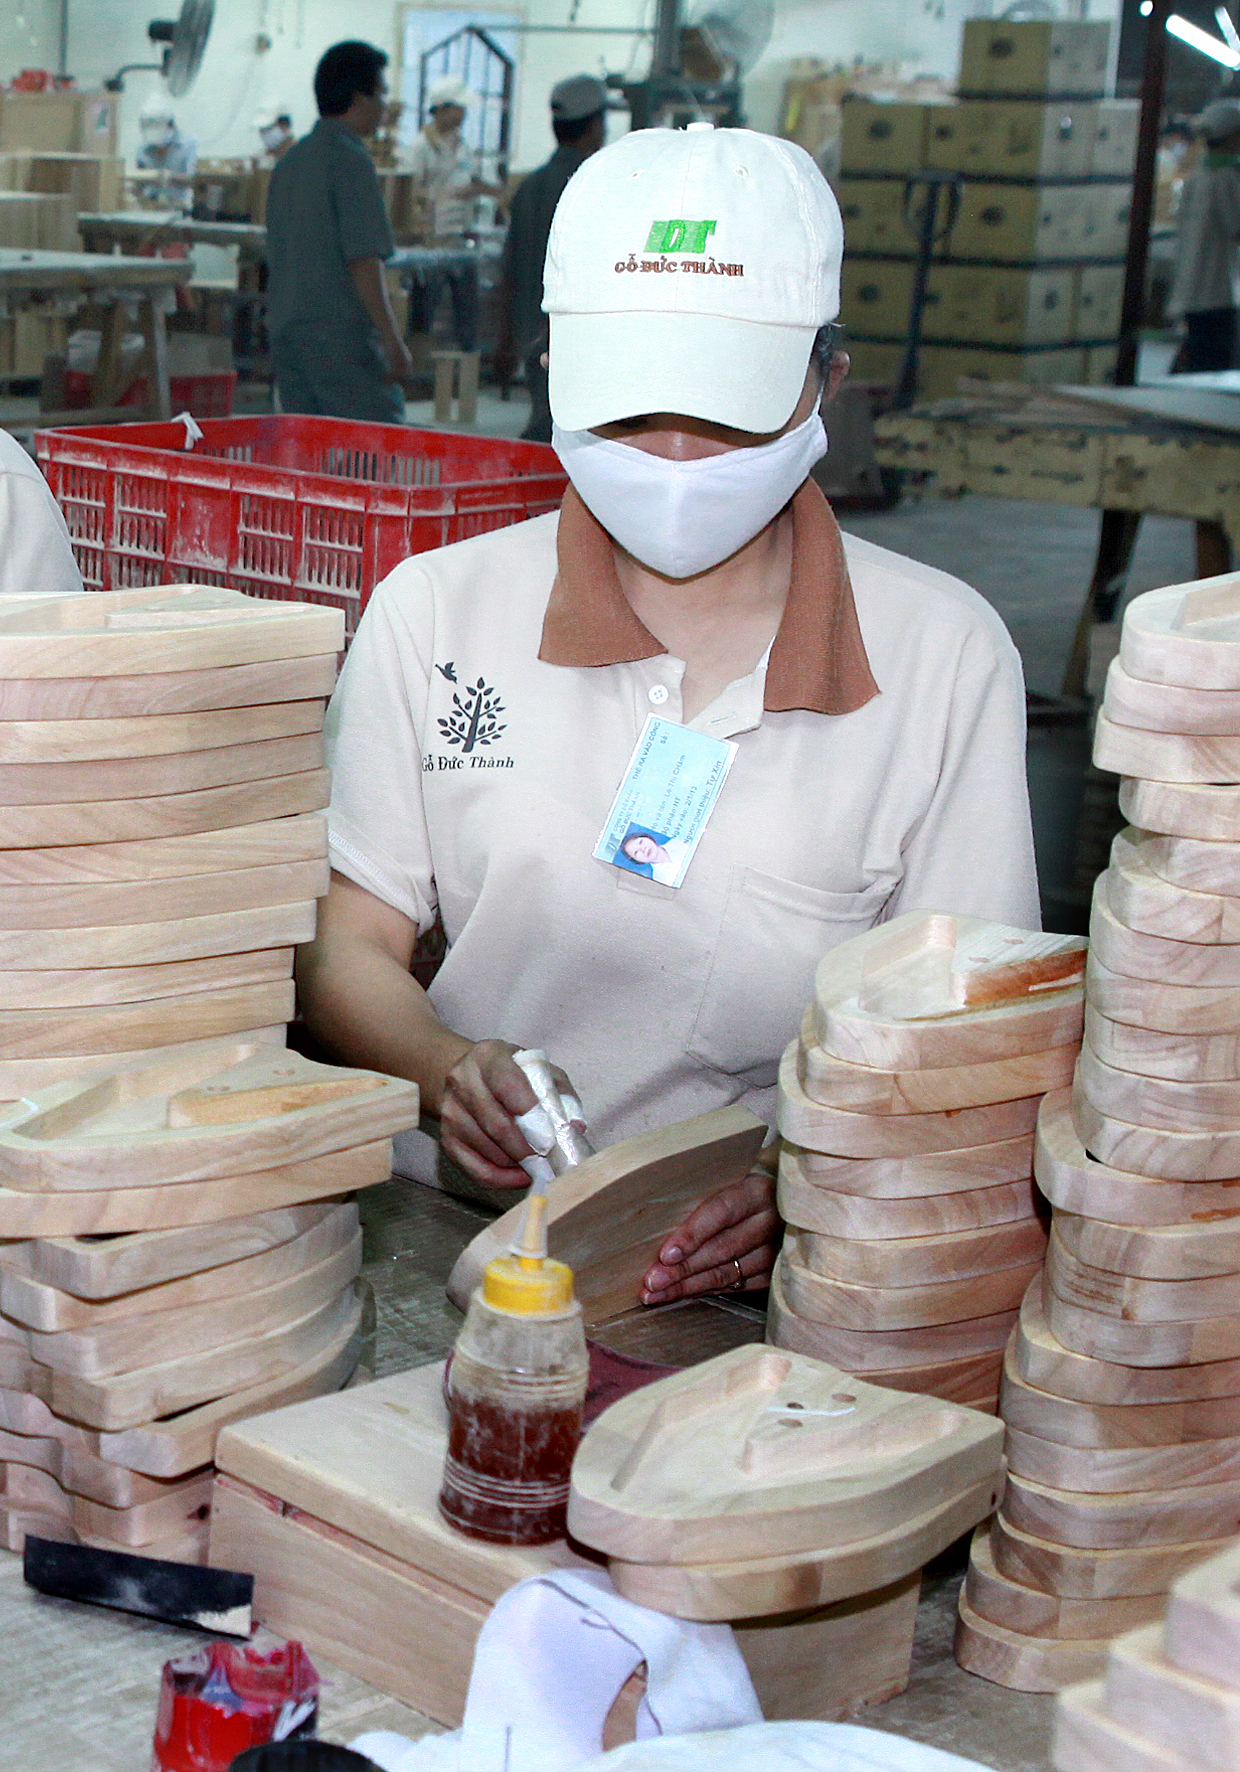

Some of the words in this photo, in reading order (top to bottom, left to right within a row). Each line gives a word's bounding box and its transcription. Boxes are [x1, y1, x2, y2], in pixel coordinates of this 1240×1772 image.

[614, 253, 638, 273] GỖ
[640, 255, 678, 273] ĐỨC
[680, 256, 744, 277] THÀNH
[438, 756, 464, 771] Đức
[469, 756, 515, 768] Thành
